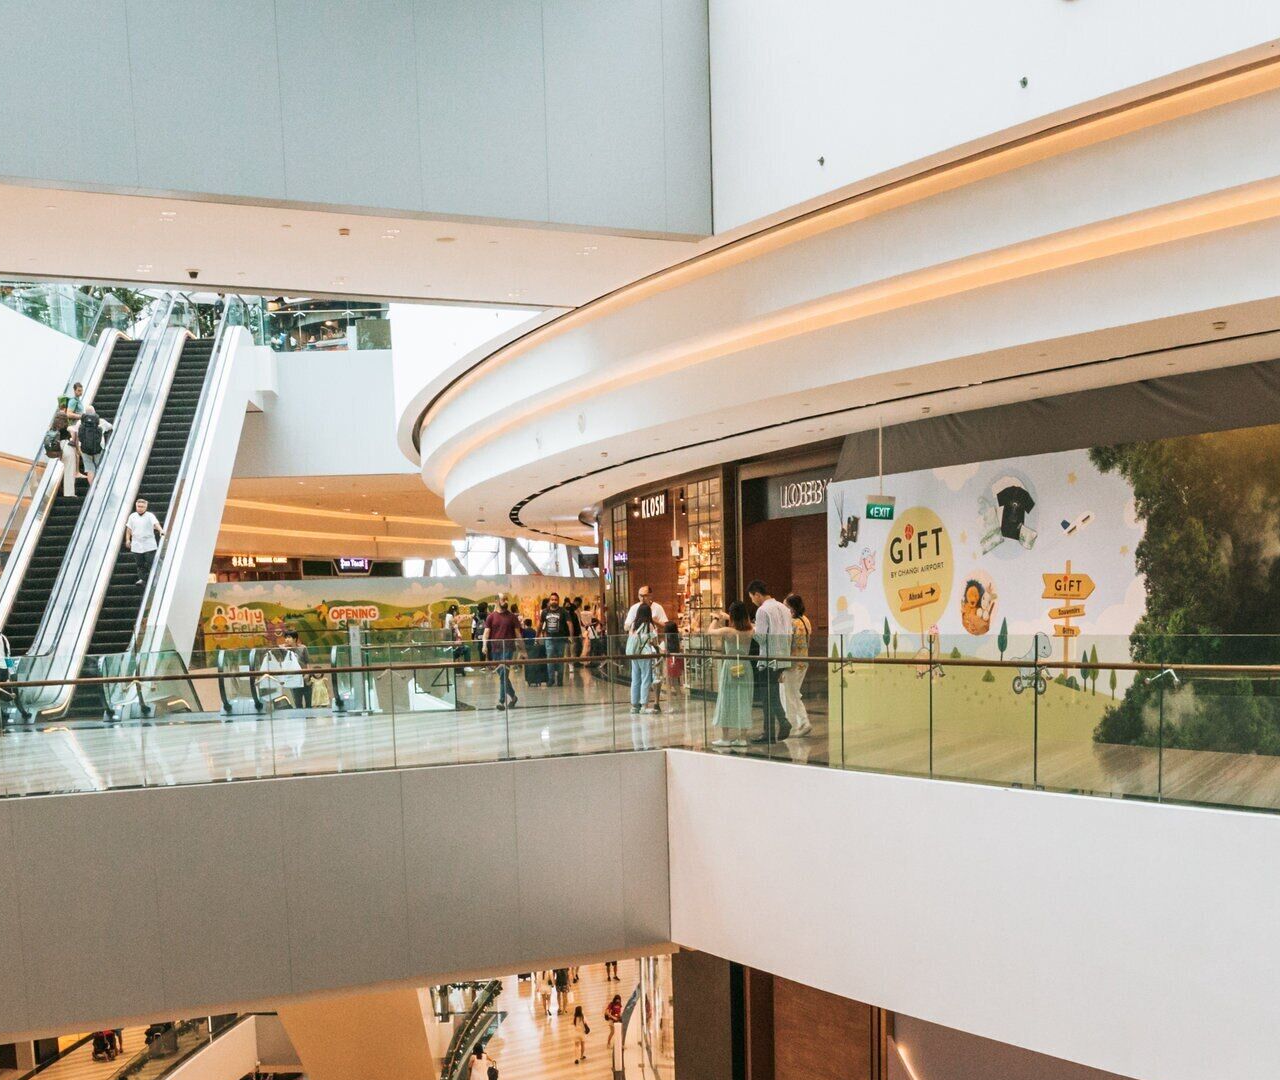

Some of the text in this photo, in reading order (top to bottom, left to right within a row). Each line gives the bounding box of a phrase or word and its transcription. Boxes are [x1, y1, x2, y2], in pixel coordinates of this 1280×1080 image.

[641, 494, 665, 519] KLOSH
[873, 507, 891, 518] EXIT
[898, 567, 920, 577] CHANGI
[921, 561, 945, 573] AIRPORT
[908, 590, 924, 601] Ahead
[227, 606, 264, 625] Jolly
[331, 606, 377, 623] OPENING
